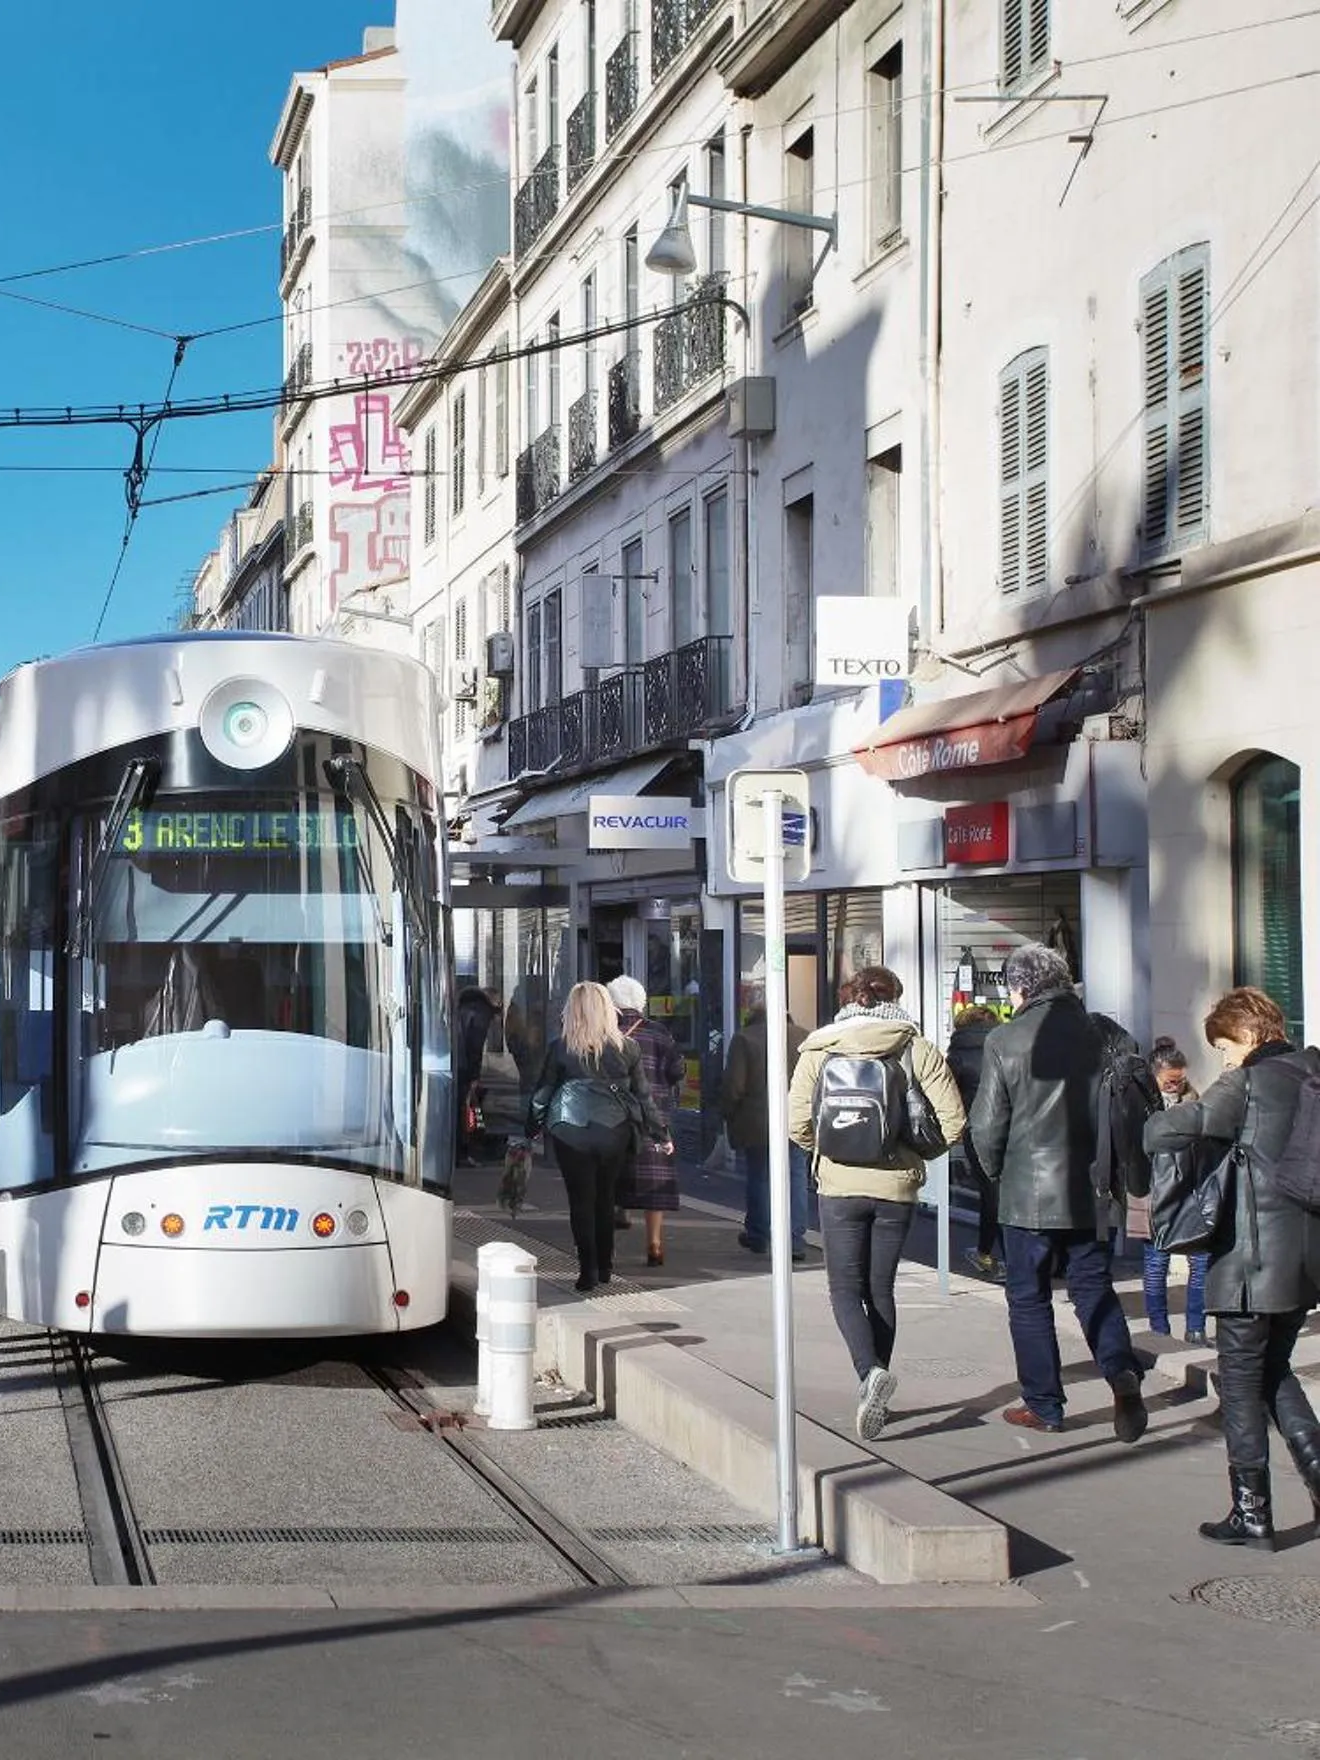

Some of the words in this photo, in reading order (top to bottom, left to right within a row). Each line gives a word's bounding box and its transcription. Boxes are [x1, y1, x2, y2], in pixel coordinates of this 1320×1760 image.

[828, 658, 901, 676] TEXTO
[897, 740, 930, 777] Côté
[931, 739, 980, 768] Rome
[123, 808, 144, 850] 3
[157, 812, 246, 848] ARENC
[253, 812, 290, 848] LE
[592, 815, 688, 829] REVACUIR
[203, 1205, 300, 1232] RTM
